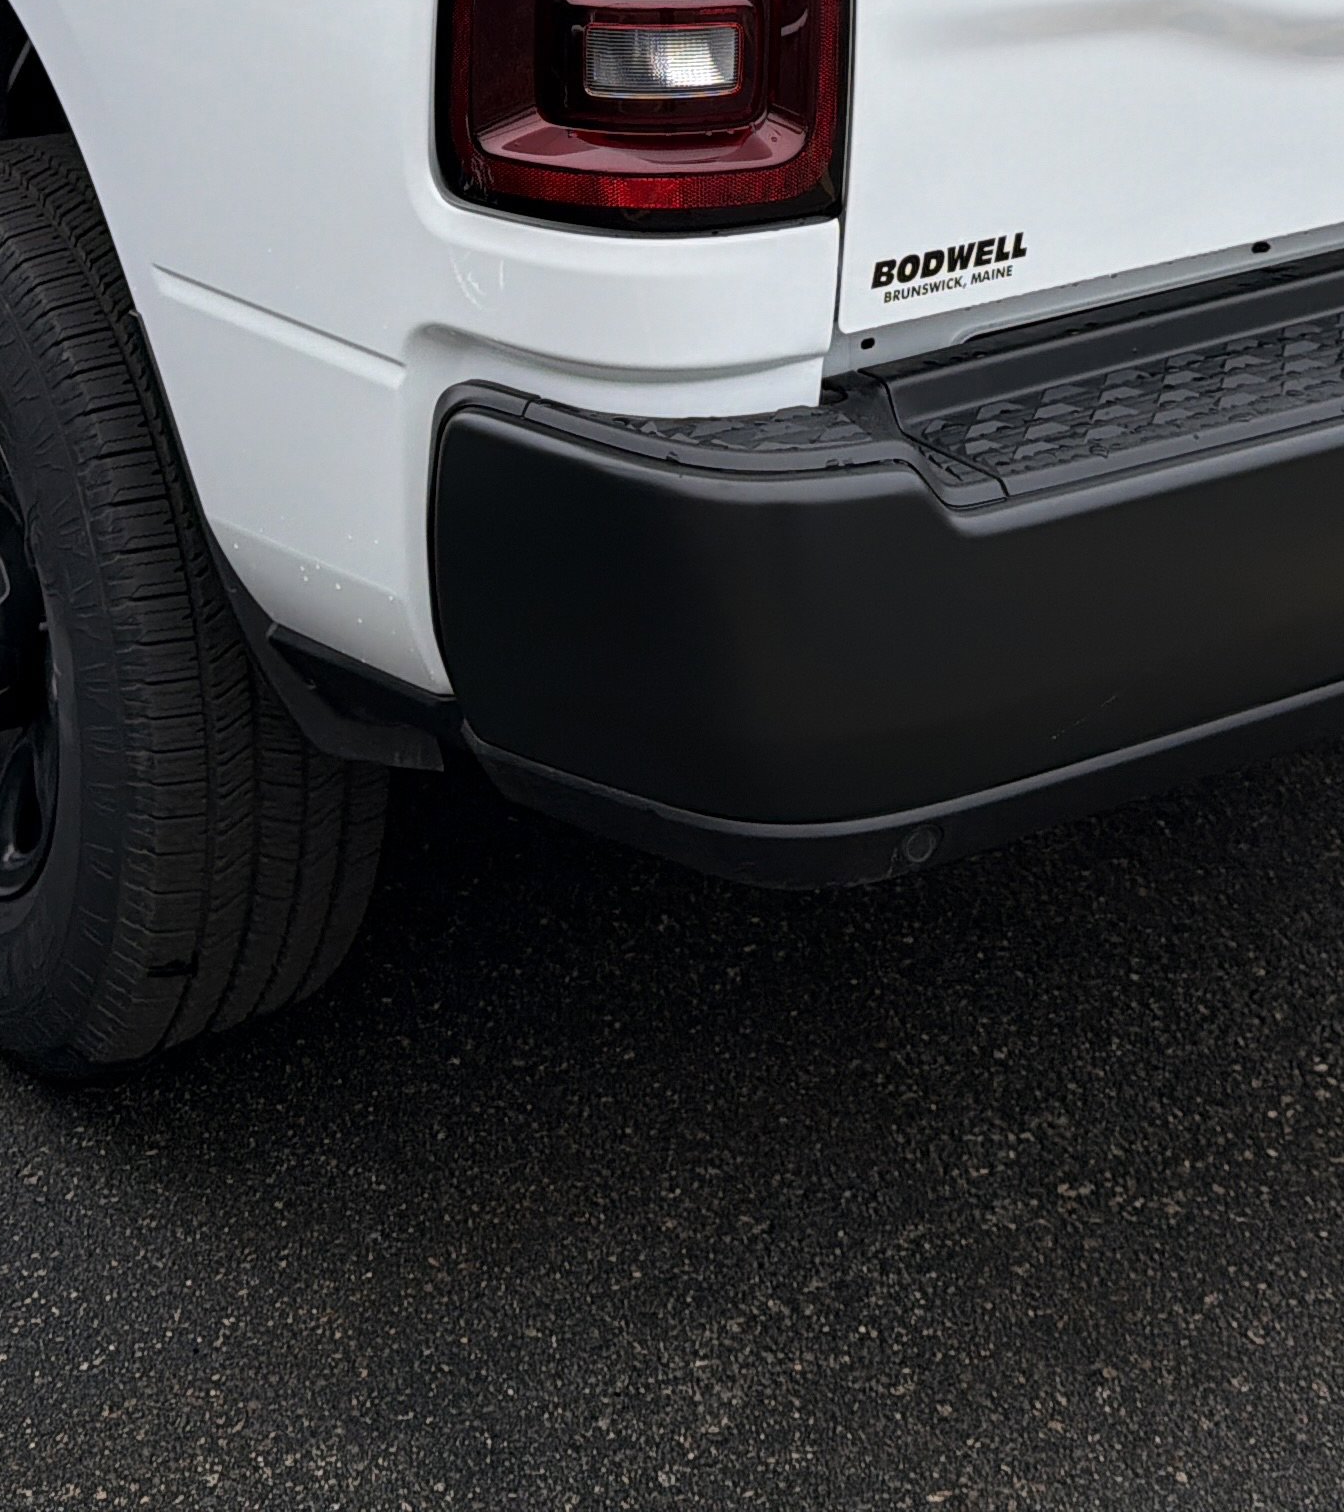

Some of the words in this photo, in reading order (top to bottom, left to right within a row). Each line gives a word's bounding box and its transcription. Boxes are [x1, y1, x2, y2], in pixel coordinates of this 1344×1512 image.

[870, 231, 1028, 289] BODWELL
[883, 276, 968, 304] BRUNSWICK,
[970, 265, 1014, 286] MAINE
